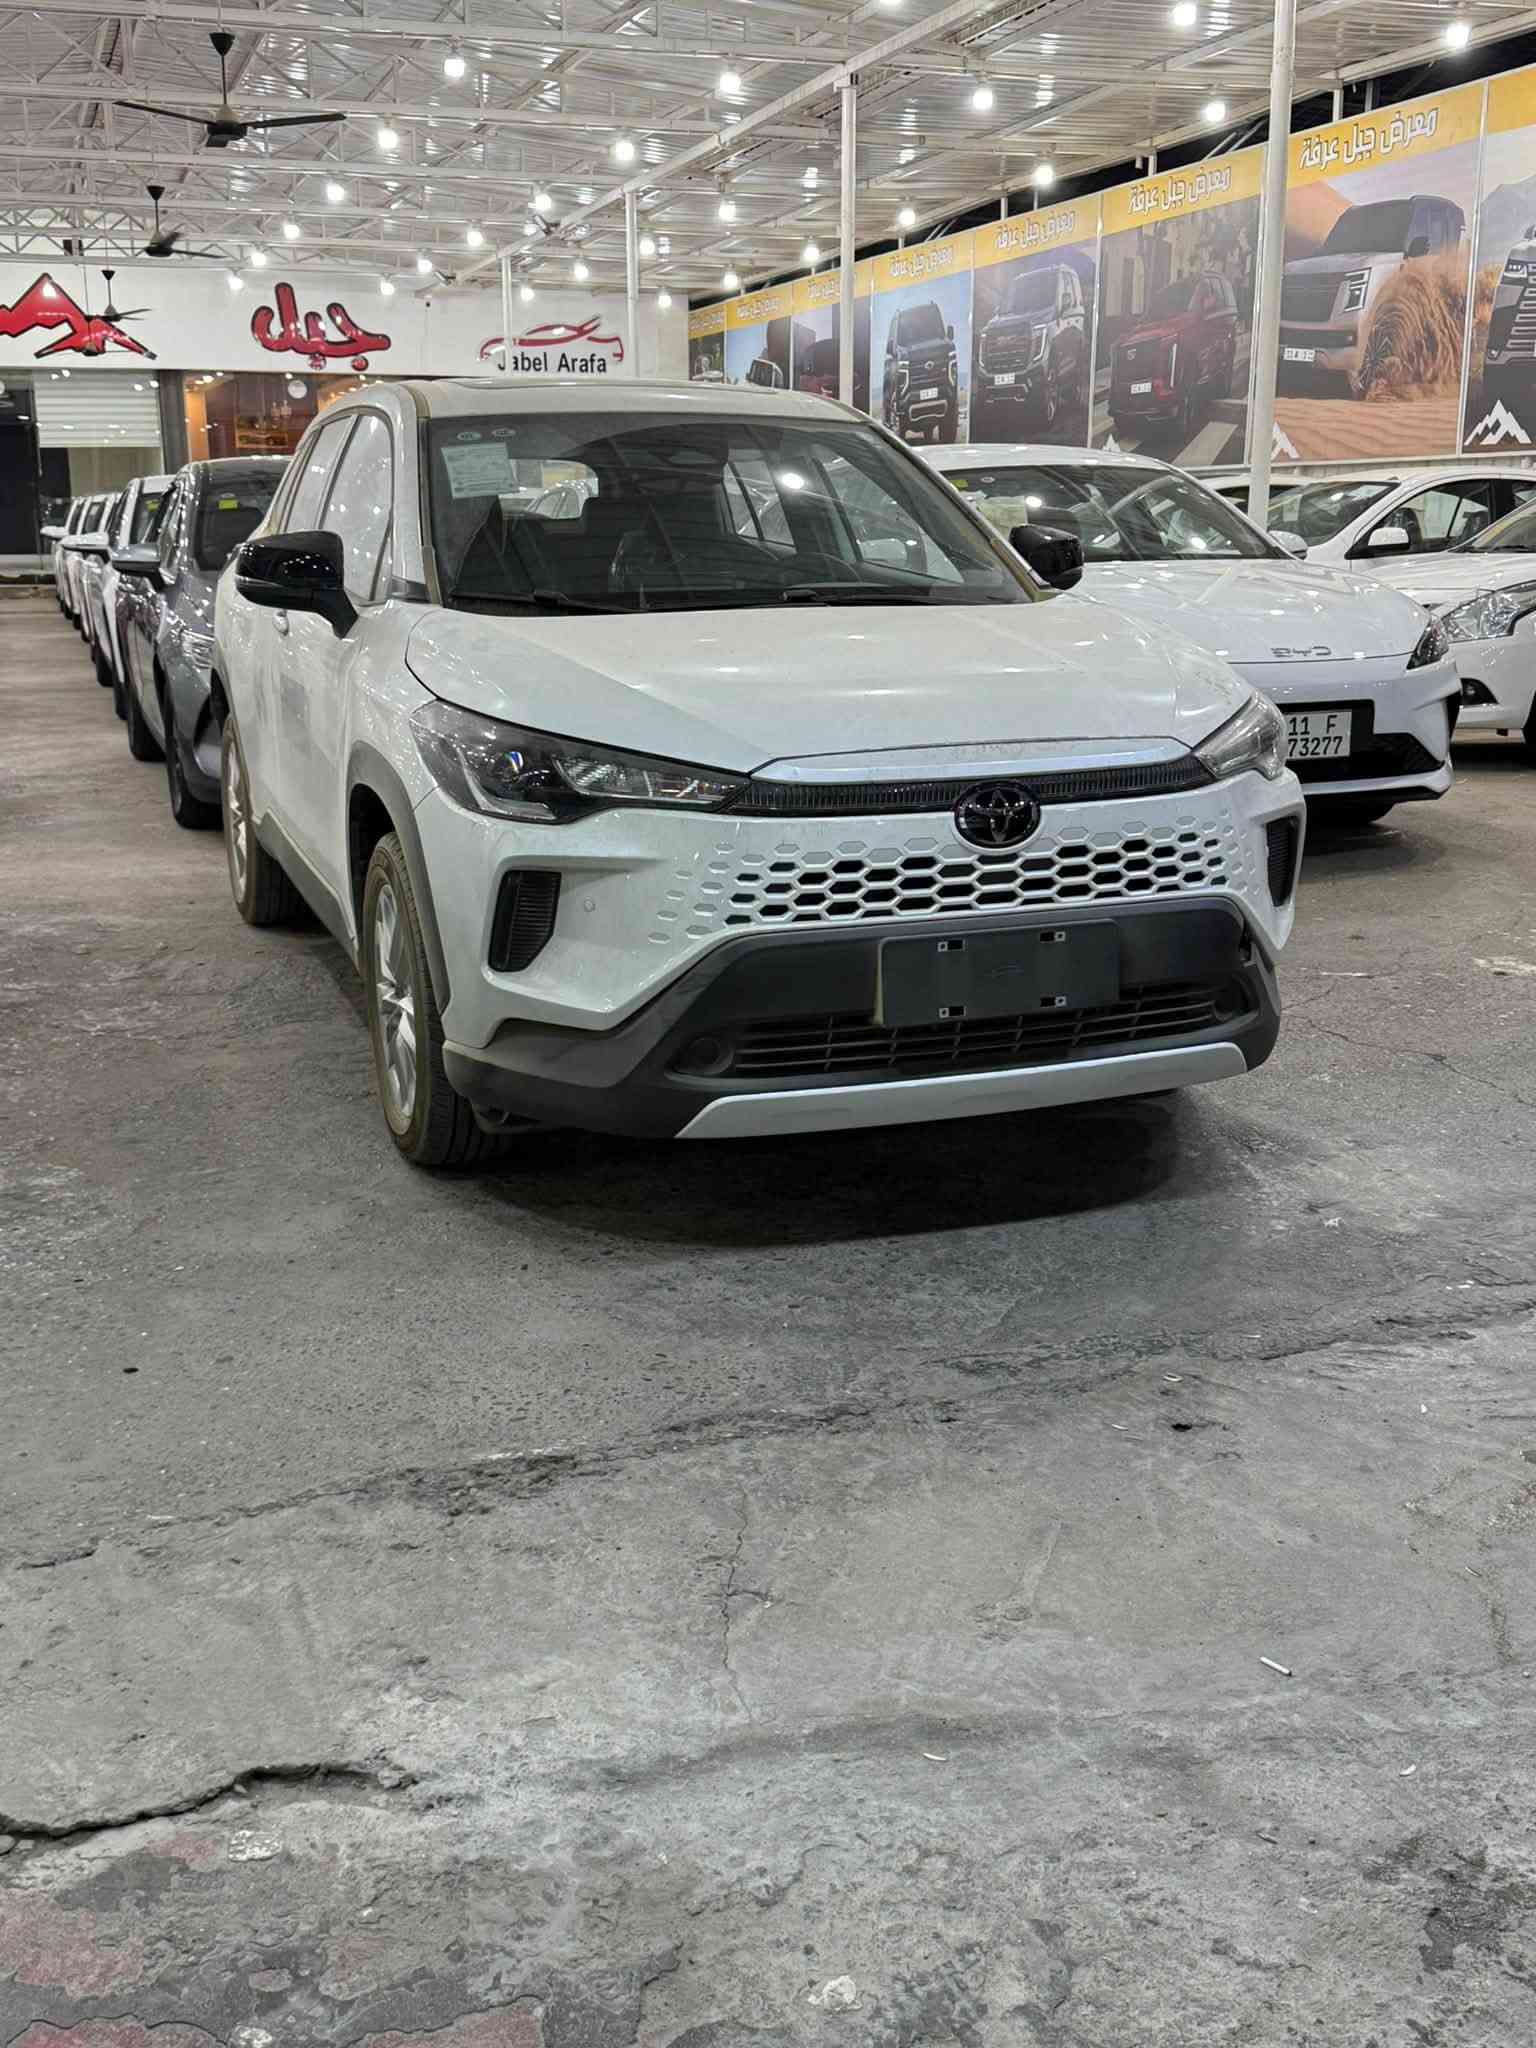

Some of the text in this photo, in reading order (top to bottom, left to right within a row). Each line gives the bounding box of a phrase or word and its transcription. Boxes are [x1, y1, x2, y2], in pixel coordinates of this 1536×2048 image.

[1298, 107, 1440, 171] معرض جبل عرفة
[1127, 166, 1232, 217] معرض جبل عرفة
[251, 282, 391, 371] جبل
[497, 351, 608, 373] Jabel Arafa
[1271, 645, 1332, 658] BYD
[1288, 714, 1338, 737] 11 F
[1287, 735, 1343, 758] 73277
